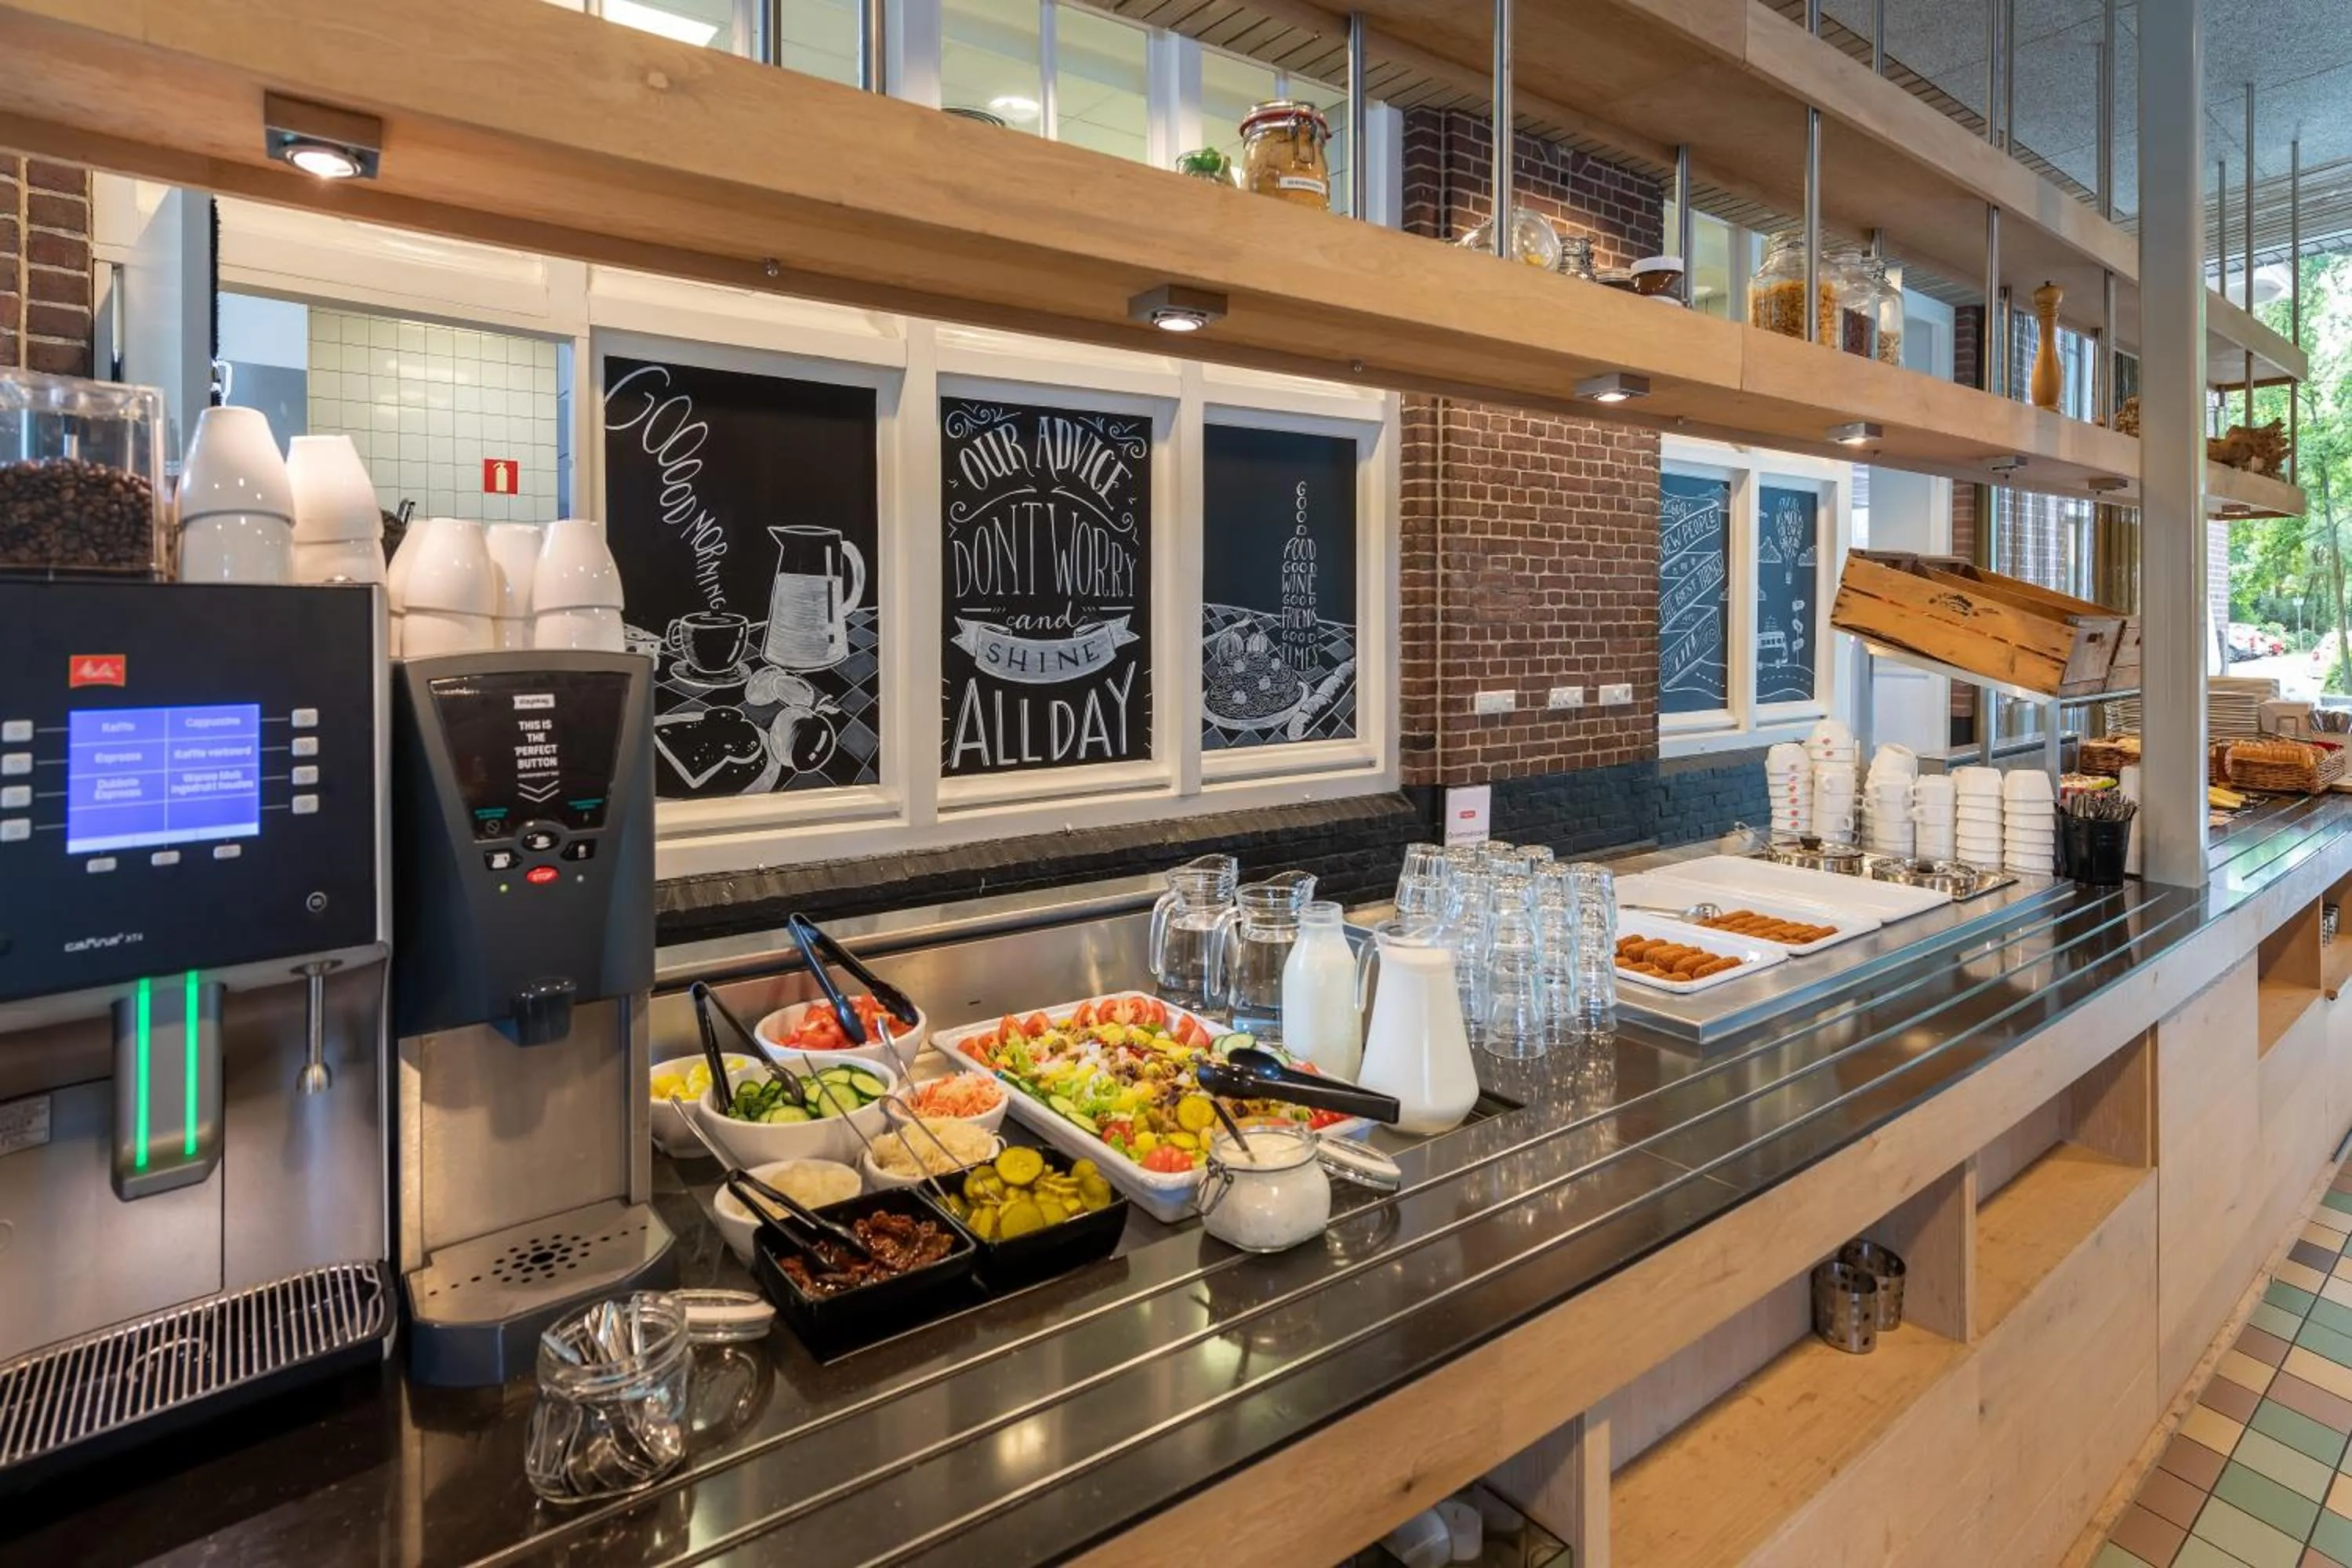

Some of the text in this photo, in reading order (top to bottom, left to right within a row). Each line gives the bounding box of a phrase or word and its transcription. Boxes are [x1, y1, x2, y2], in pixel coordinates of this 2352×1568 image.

[959, 416, 1133, 510] OUR ADVICE
[1296, 481, 1307, 535] GOOD
[1682, 510, 1719, 544] PEOPLE
[680, 509, 728, 609] MORNING
[1047, 503, 1137, 597] WORRY
[1283, 537, 1316, 560] FOOD
[1282, 561, 1318, 573] GOOD
[1282, 573, 1317, 595] WINE
[1282, 594, 1316, 605] GOOD
[1007, 600, 1089, 630] and
[1282, 630, 1316, 643] GOOD
[985, 640, 1102, 673] SHINE
[1282, 642, 1318, 670] TIMES
[519, 719, 552, 731] THIS IS
[949, 661, 1136, 769] ALL DAY
[527, 732, 546, 742] THE
[514, 745, 557, 757] PERFECT
[517, 757, 557, 769] BUTTON
